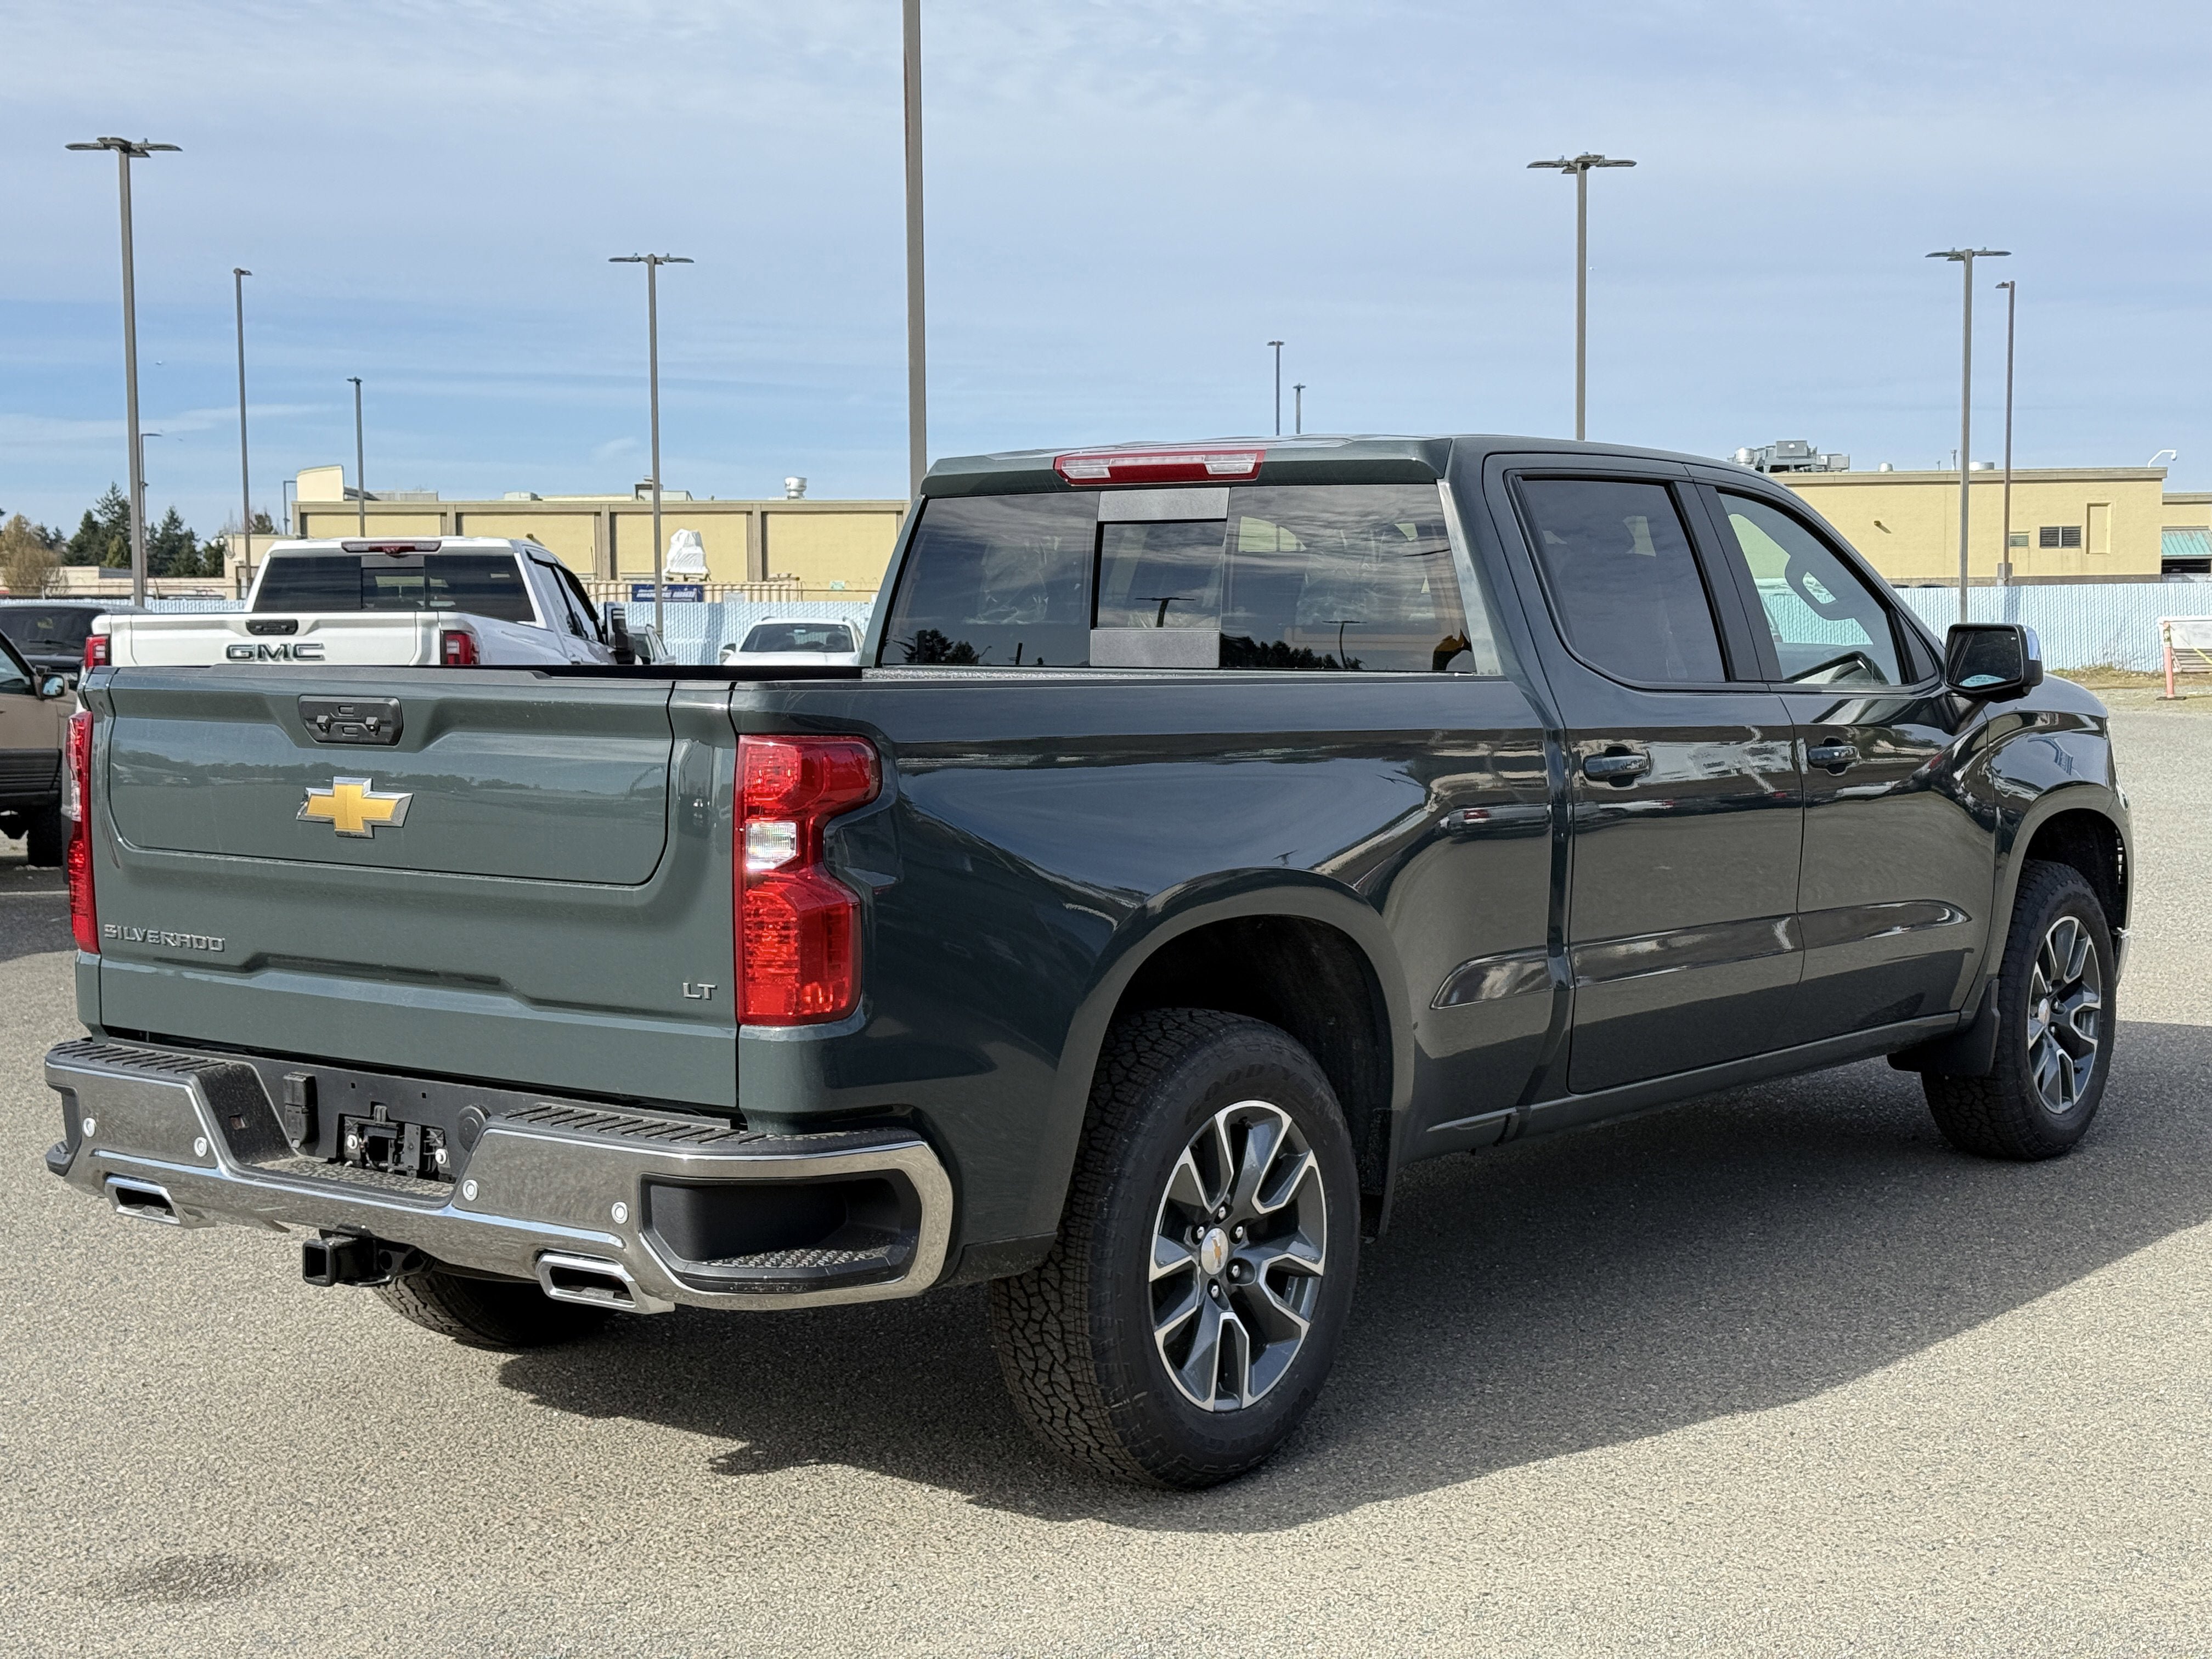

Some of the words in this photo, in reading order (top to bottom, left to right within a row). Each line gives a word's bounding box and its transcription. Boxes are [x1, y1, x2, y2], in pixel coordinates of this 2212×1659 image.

[226, 643, 325, 662] GMC
[104, 924, 225, 952] SILVERADO
[682, 982, 718, 1001] LT
[1185, 1063, 1340, 1130] GOODYE
